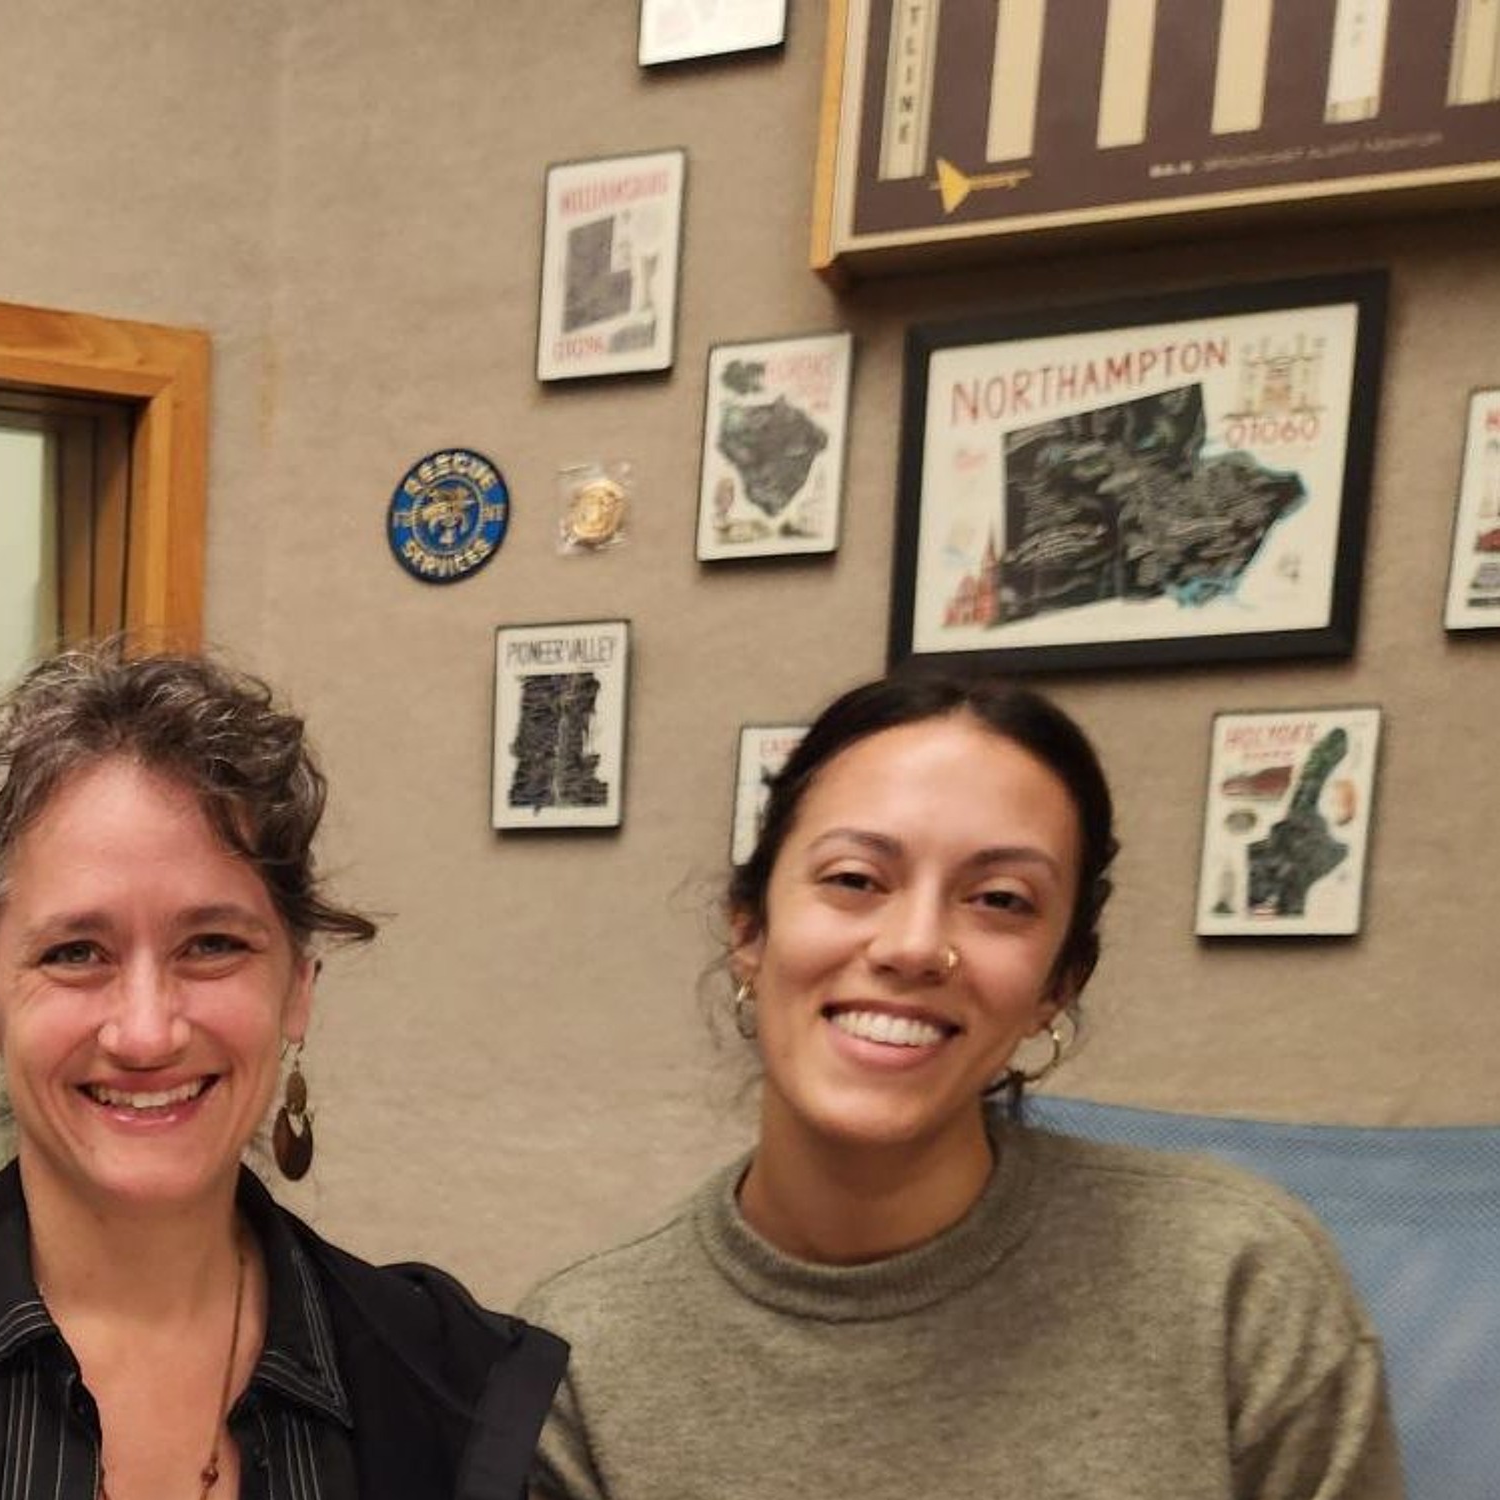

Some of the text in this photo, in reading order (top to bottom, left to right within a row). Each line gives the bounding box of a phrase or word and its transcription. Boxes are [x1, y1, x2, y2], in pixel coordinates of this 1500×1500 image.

[951, 338, 1231, 426] NORTHAMPTON
[1224, 414, 1321, 450] 01060
[507, 636, 617, 668] PIONEER VALLEY
